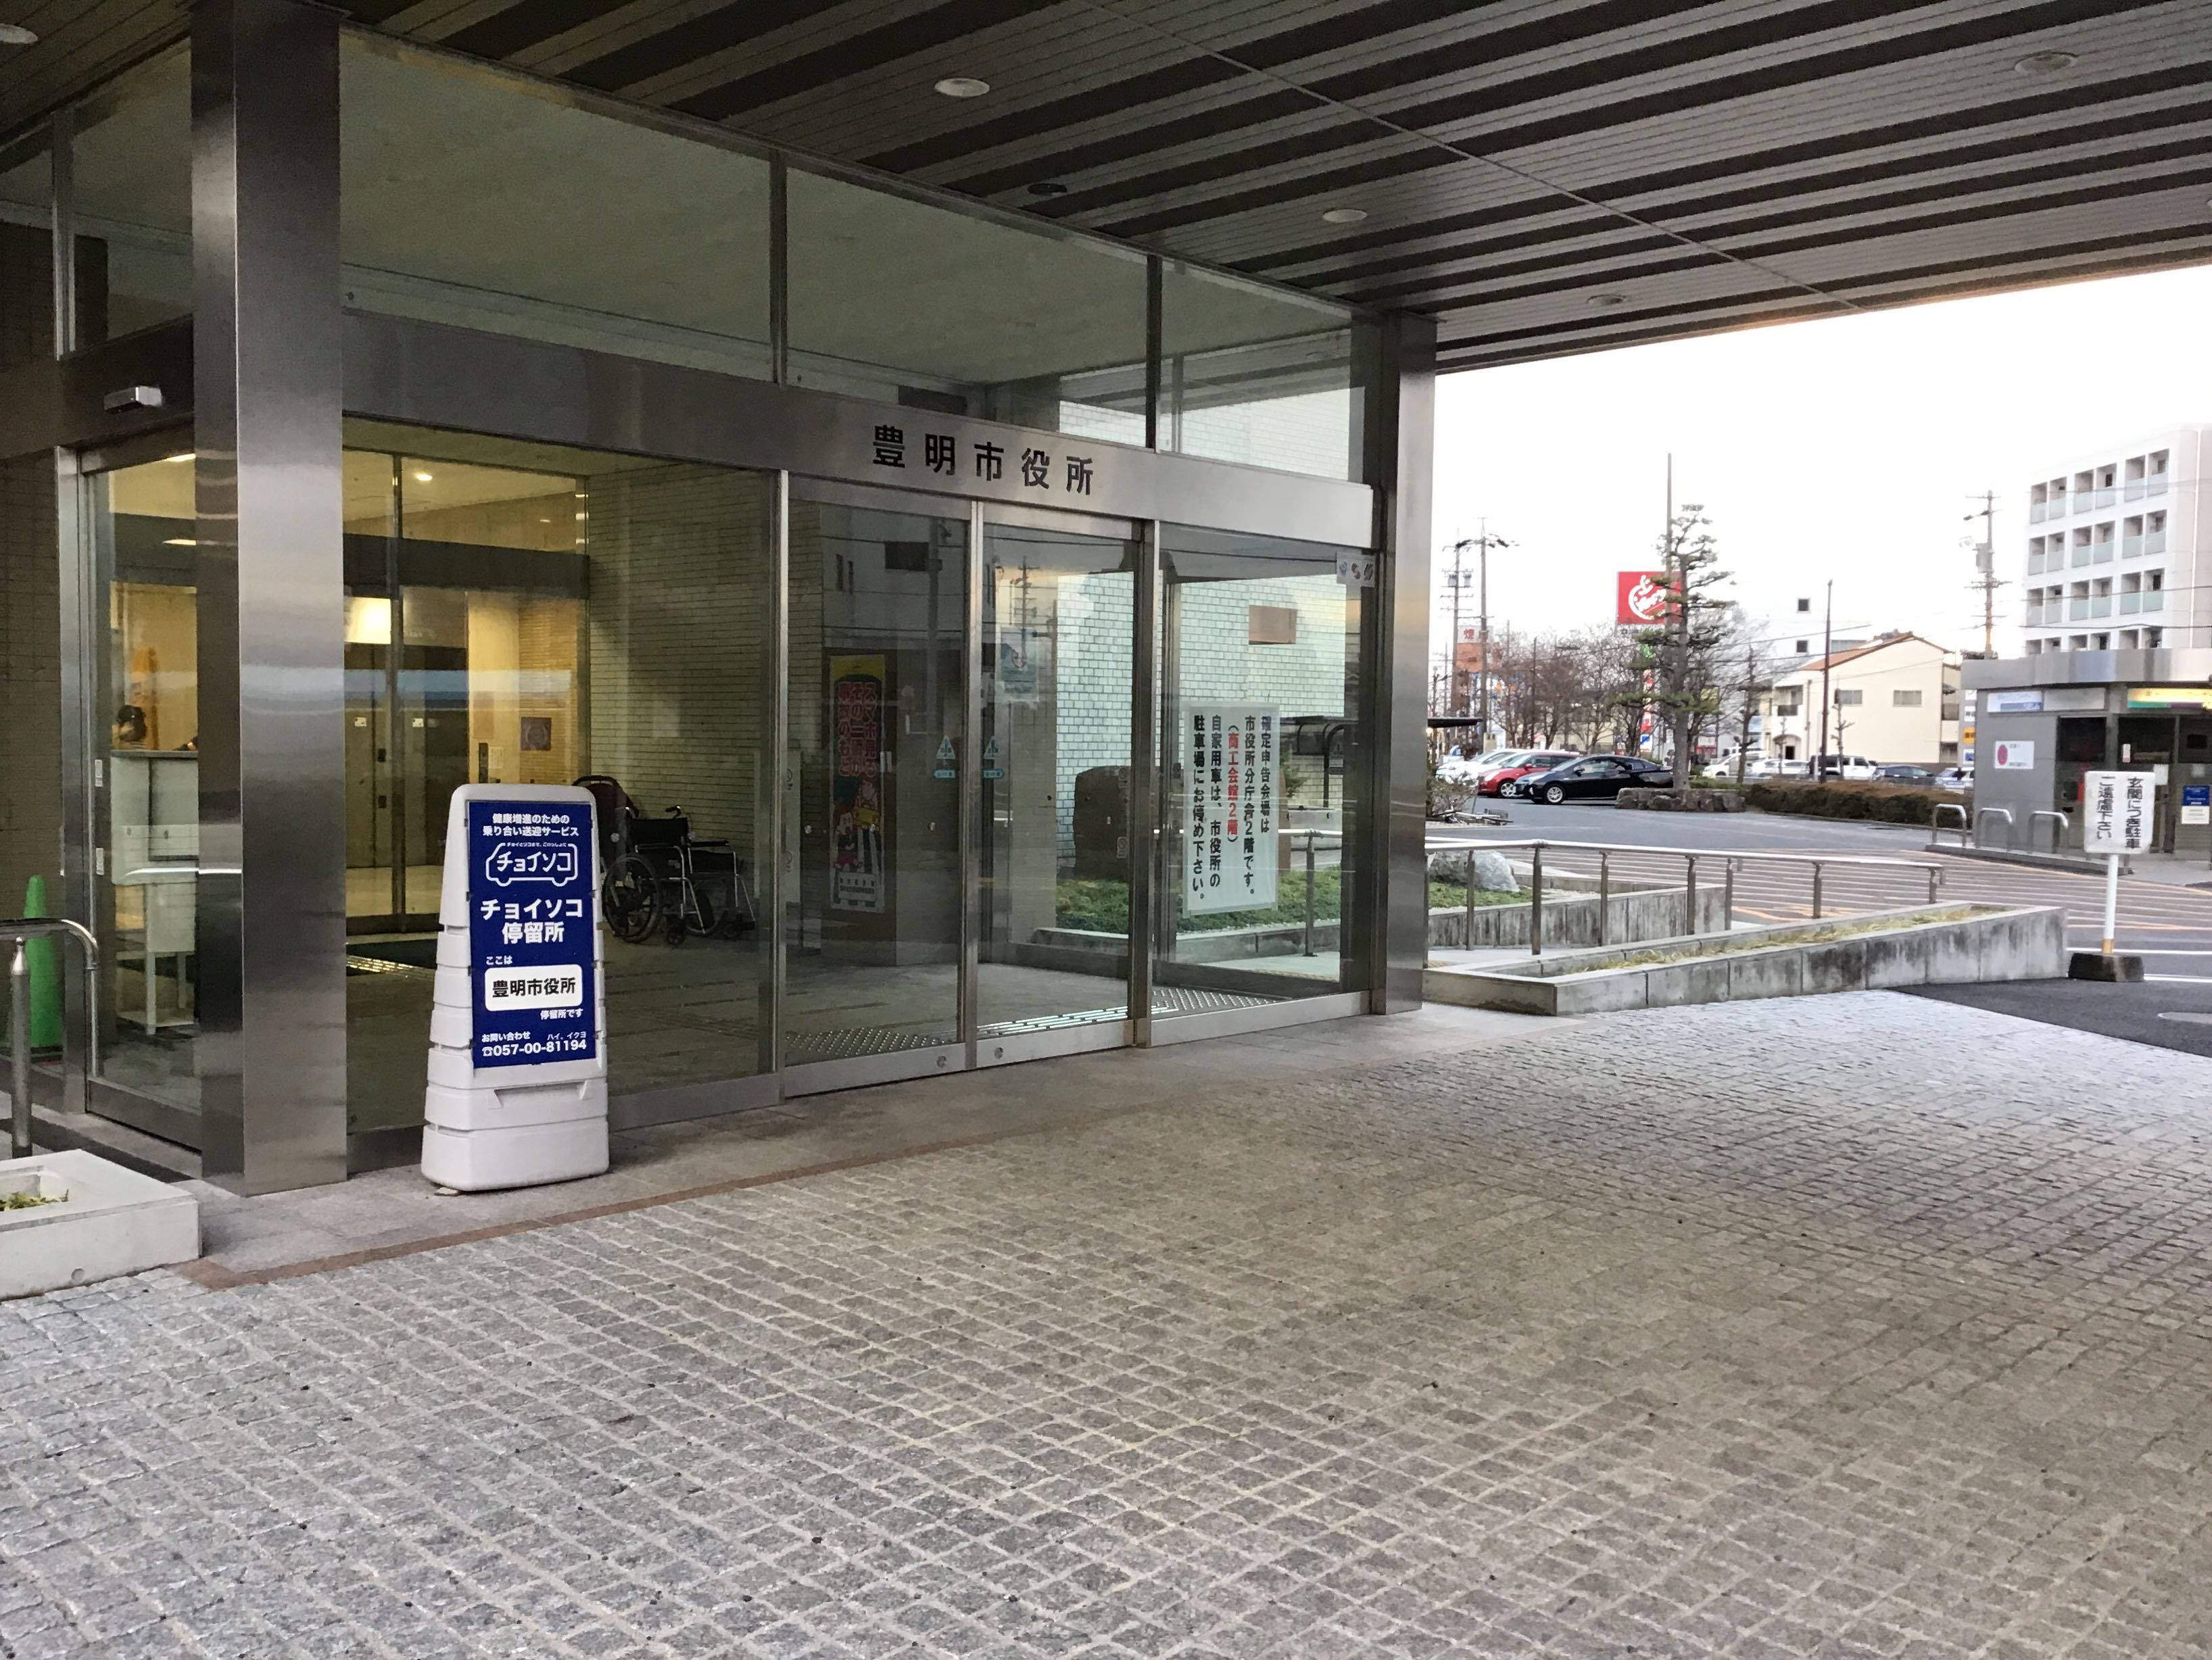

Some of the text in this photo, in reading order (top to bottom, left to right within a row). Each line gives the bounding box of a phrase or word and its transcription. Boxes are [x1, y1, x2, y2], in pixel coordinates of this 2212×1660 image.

[873, 424, 1093, 495] 豊明市役所
[1260, 716, 1272, 833] 確定申告会場は
[492, 813, 570, 825] 健康増進のための
[2125, 777, 2144, 849] 玄関につき駐車
[483, 825, 579, 837] 乗り合い送迎サービス
[496, 851, 571, 872] チョイソコ
[480, 898, 583, 921] チョイソコ
[502, 921, 564, 944] 停留所
[485, 955, 512, 965] ここは
[492, 977, 576, 998] 豊明市役所
[540, 1008, 583, 1020] 停留所です
[481, 1031, 531, 1043] お問い合わせ
